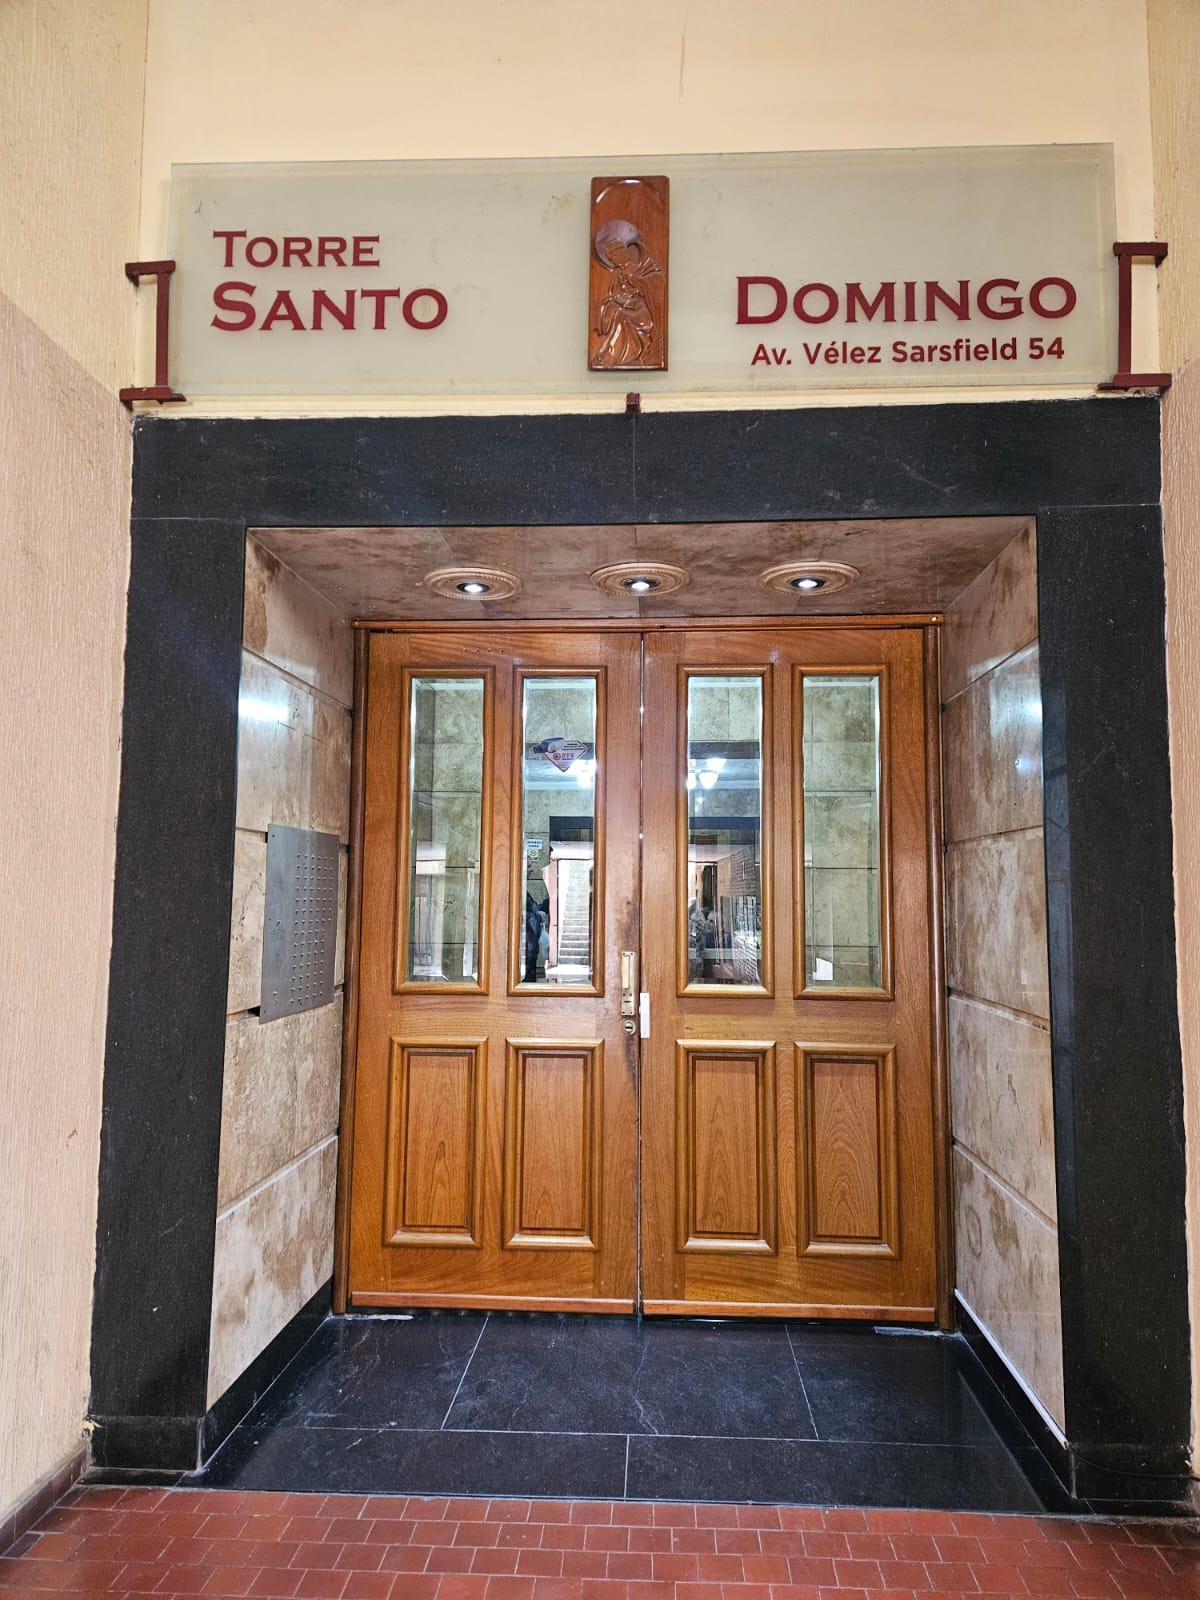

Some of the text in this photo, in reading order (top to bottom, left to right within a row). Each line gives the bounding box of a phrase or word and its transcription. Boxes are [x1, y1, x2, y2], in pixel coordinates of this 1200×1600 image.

[213, 230, 380, 269] TORRE
[211, 275, 1078, 333] SANTO DOMINGO
[751, 336, 1065, 366] Av. Vélez Sarsfield 54
